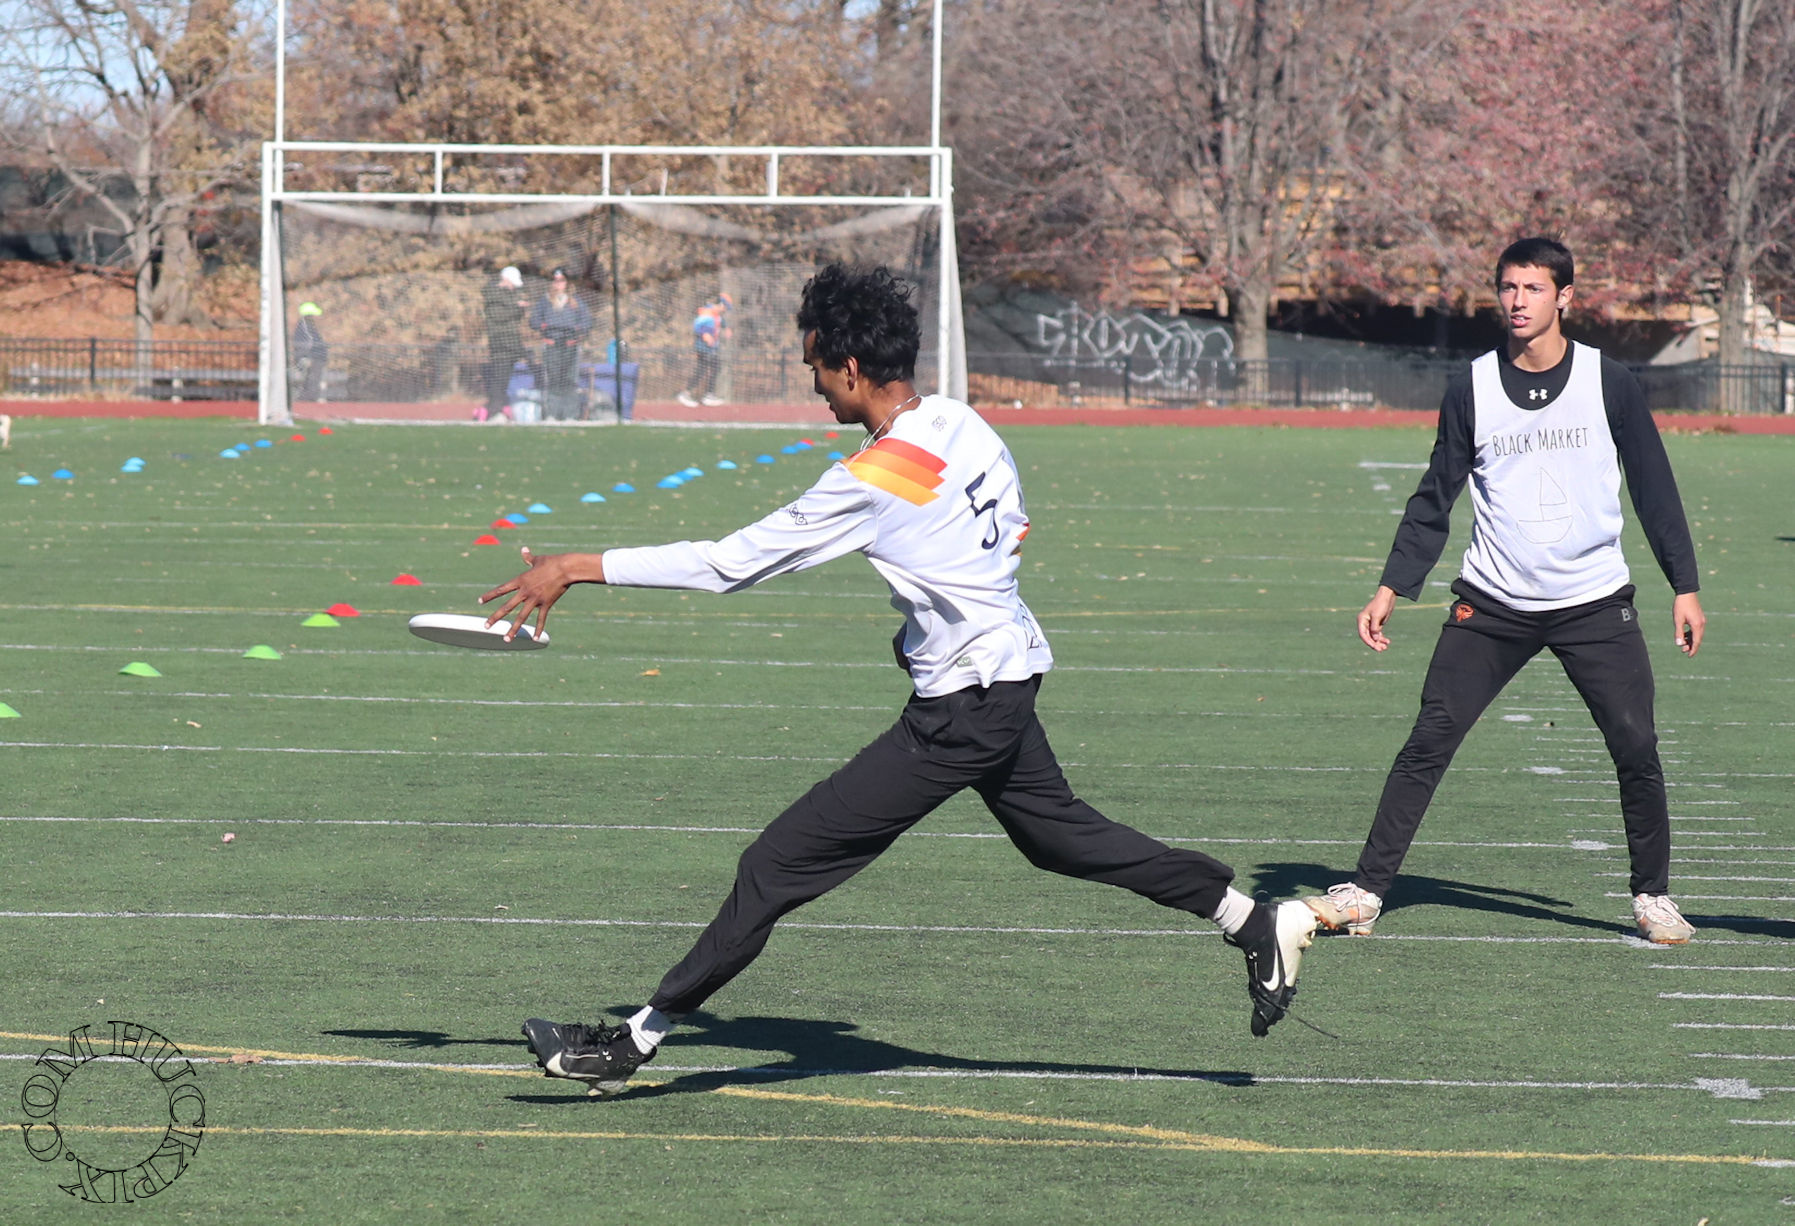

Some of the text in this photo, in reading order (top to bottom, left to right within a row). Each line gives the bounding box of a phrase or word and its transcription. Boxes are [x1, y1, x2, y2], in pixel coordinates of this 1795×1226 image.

[1492, 427, 1588, 457] BLACK MARKET
[965, 471, 999, 550] 5
